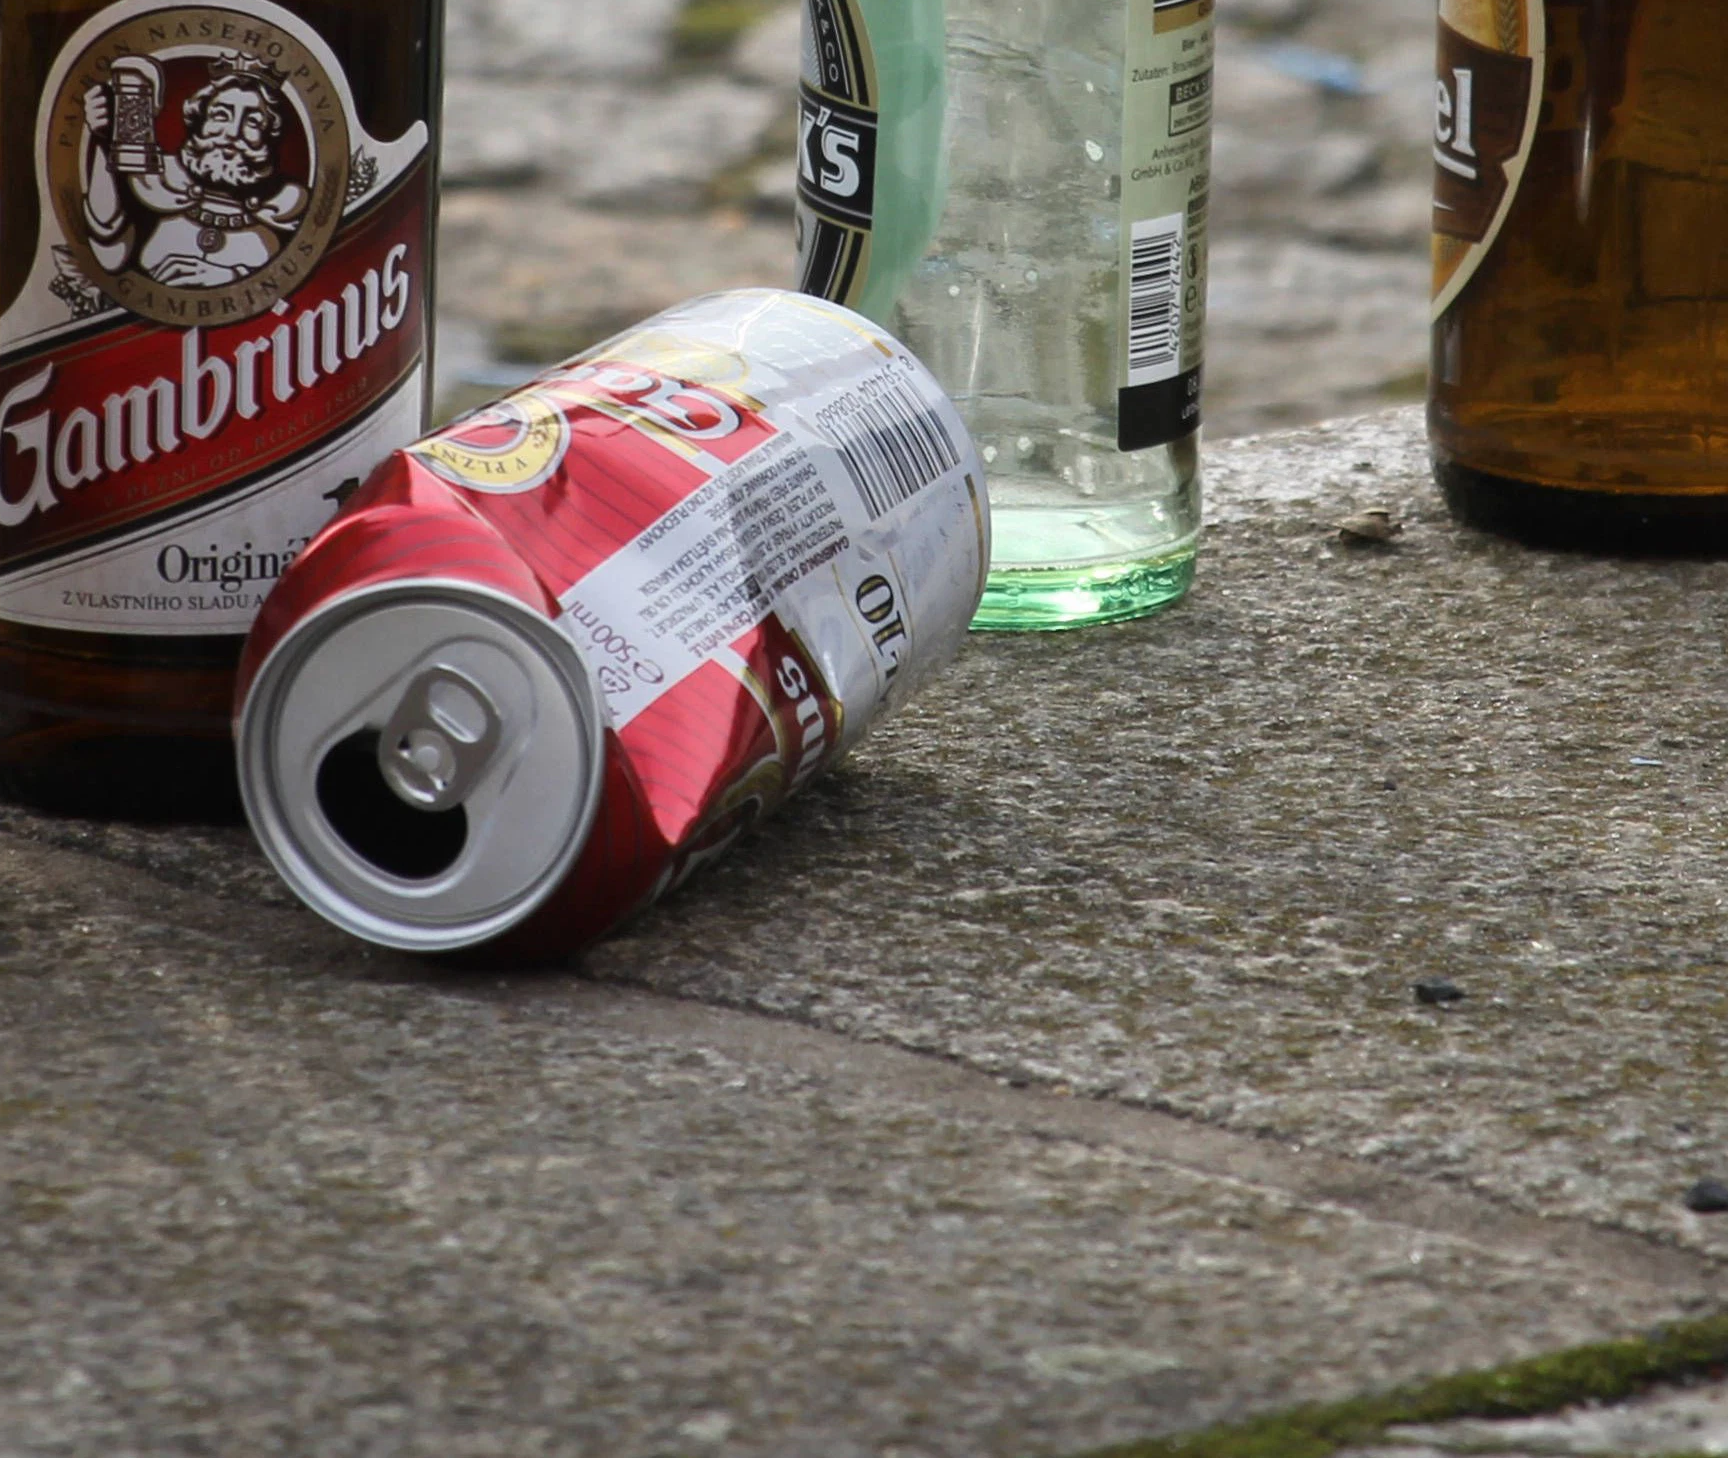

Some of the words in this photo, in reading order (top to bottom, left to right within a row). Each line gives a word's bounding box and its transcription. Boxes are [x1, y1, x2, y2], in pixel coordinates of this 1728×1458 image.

[118, 240, 315, 319] GAMBRINUS
[157, 537, 312, 593] Originá
[62, 590, 73, 607] Z
[76, 592, 183, 611] VLASTNÍHO
[187, 593, 249, 611] SLADU
[855, 573, 907, 657] 10
